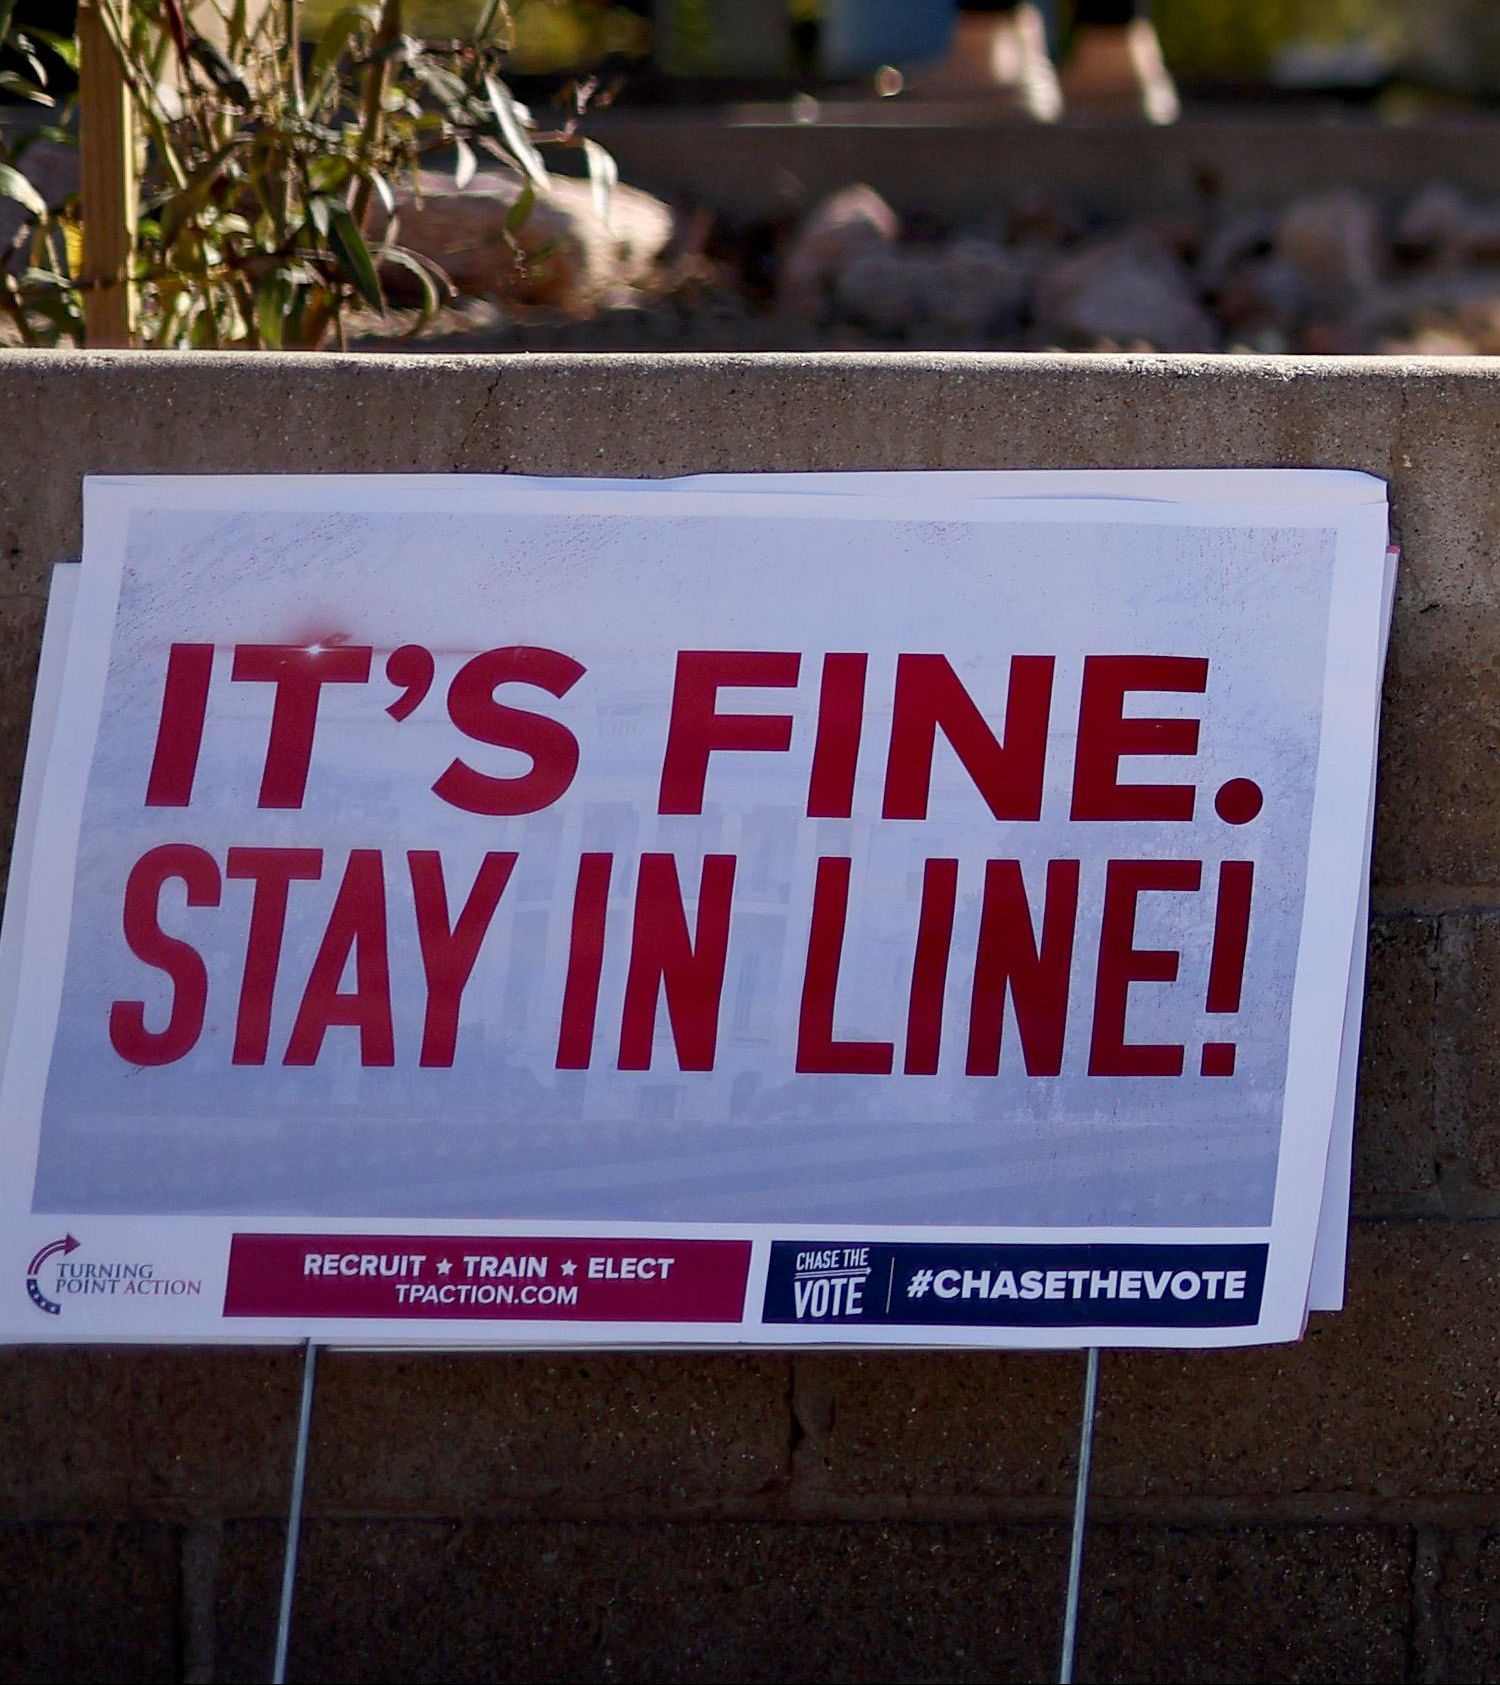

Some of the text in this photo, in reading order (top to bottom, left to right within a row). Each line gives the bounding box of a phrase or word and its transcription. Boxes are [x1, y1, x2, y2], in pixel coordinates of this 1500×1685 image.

[146, 644, 1263, 824] IT’S FINE.
[109, 843, 1255, 1076] STAY IN LINE!
[56, 1263, 154, 1279] TURNING
[303, 1253, 674, 1280] RECRUIT TRAIN ELECT
[795, 1247, 870, 1271] CHASE THE
[55, 1278, 202, 1296] POINT ACTION
[395, 1283, 578, 1305] TPACTION.COM
[794, 1276, 867, 1319] VOTE
[906, 1269, 1247, 1300] #CHASETHEVOTE
